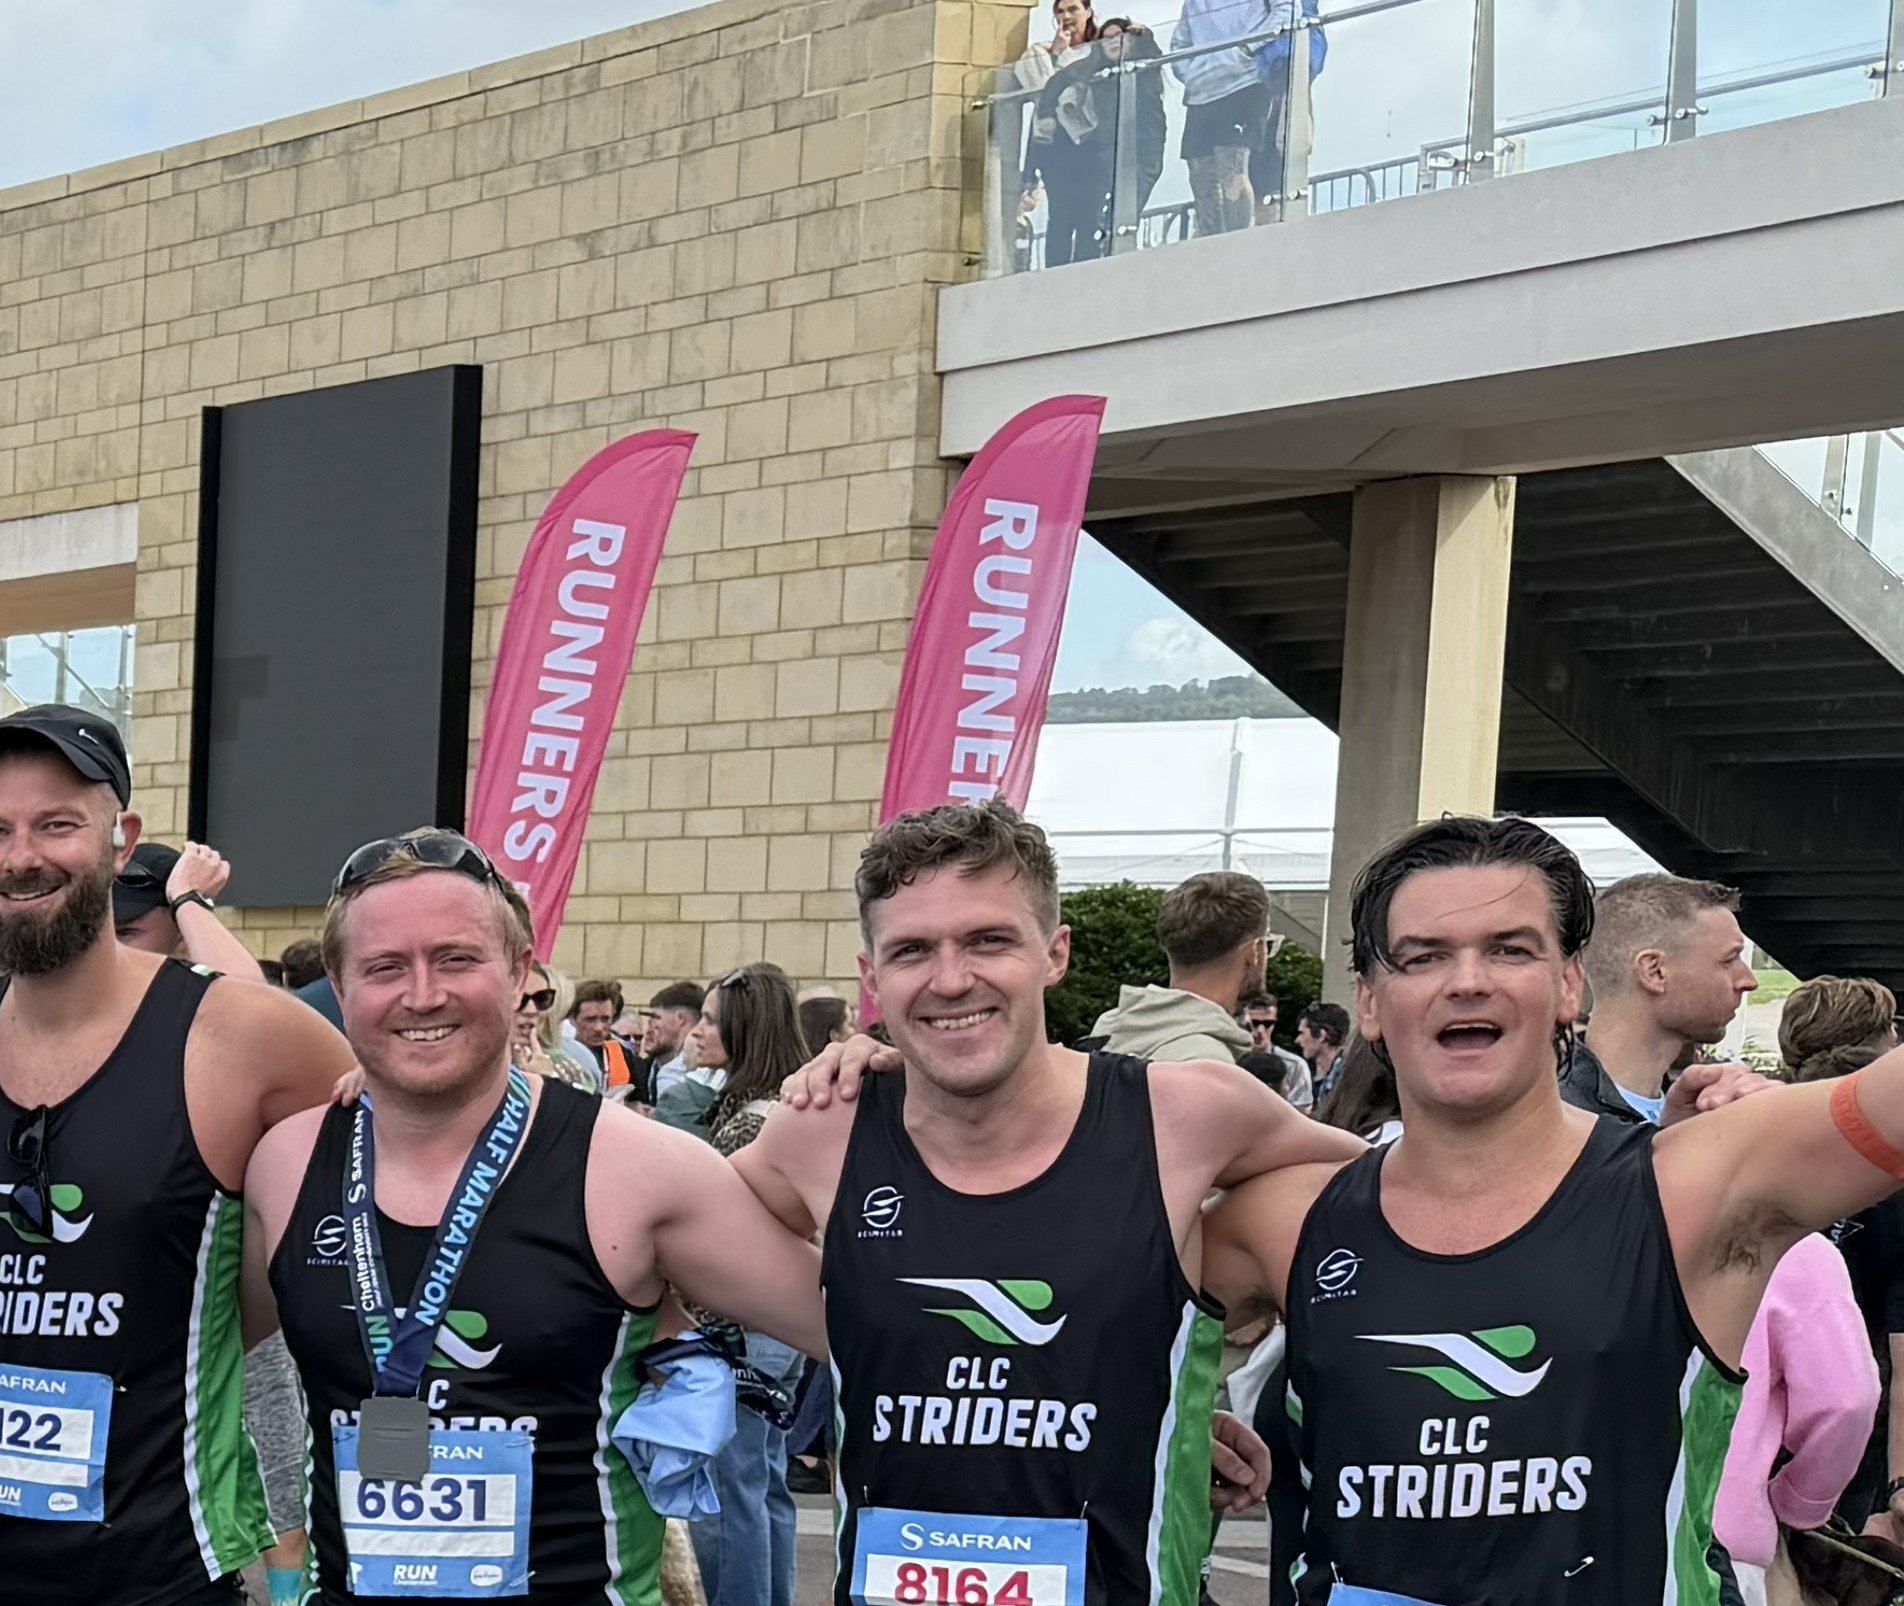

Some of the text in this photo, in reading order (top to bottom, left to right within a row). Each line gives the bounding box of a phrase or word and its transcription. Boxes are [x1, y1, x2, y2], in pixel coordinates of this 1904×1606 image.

[503, 518, 627, 864] RUNNERS
[351, 1109, 365, 1182] SAFRAN
[415, 1094, 525, 1326] HALF MARATHON
[352, 1216, 374, 1311] Cheltenham
[946, 1356, 1011, 1390] CLC
[872, 1395, 1097, 1452] STRIDERS
[1420, 1416, 1490, 1456] CLC
[357, 1477, 487, 1521] 6631
[1337, 1455, 1592, 1519] STRIDERS
[929, 1532, 1031, 1551] SAFRAN
[394, 1564, 437, 1580] RUN
